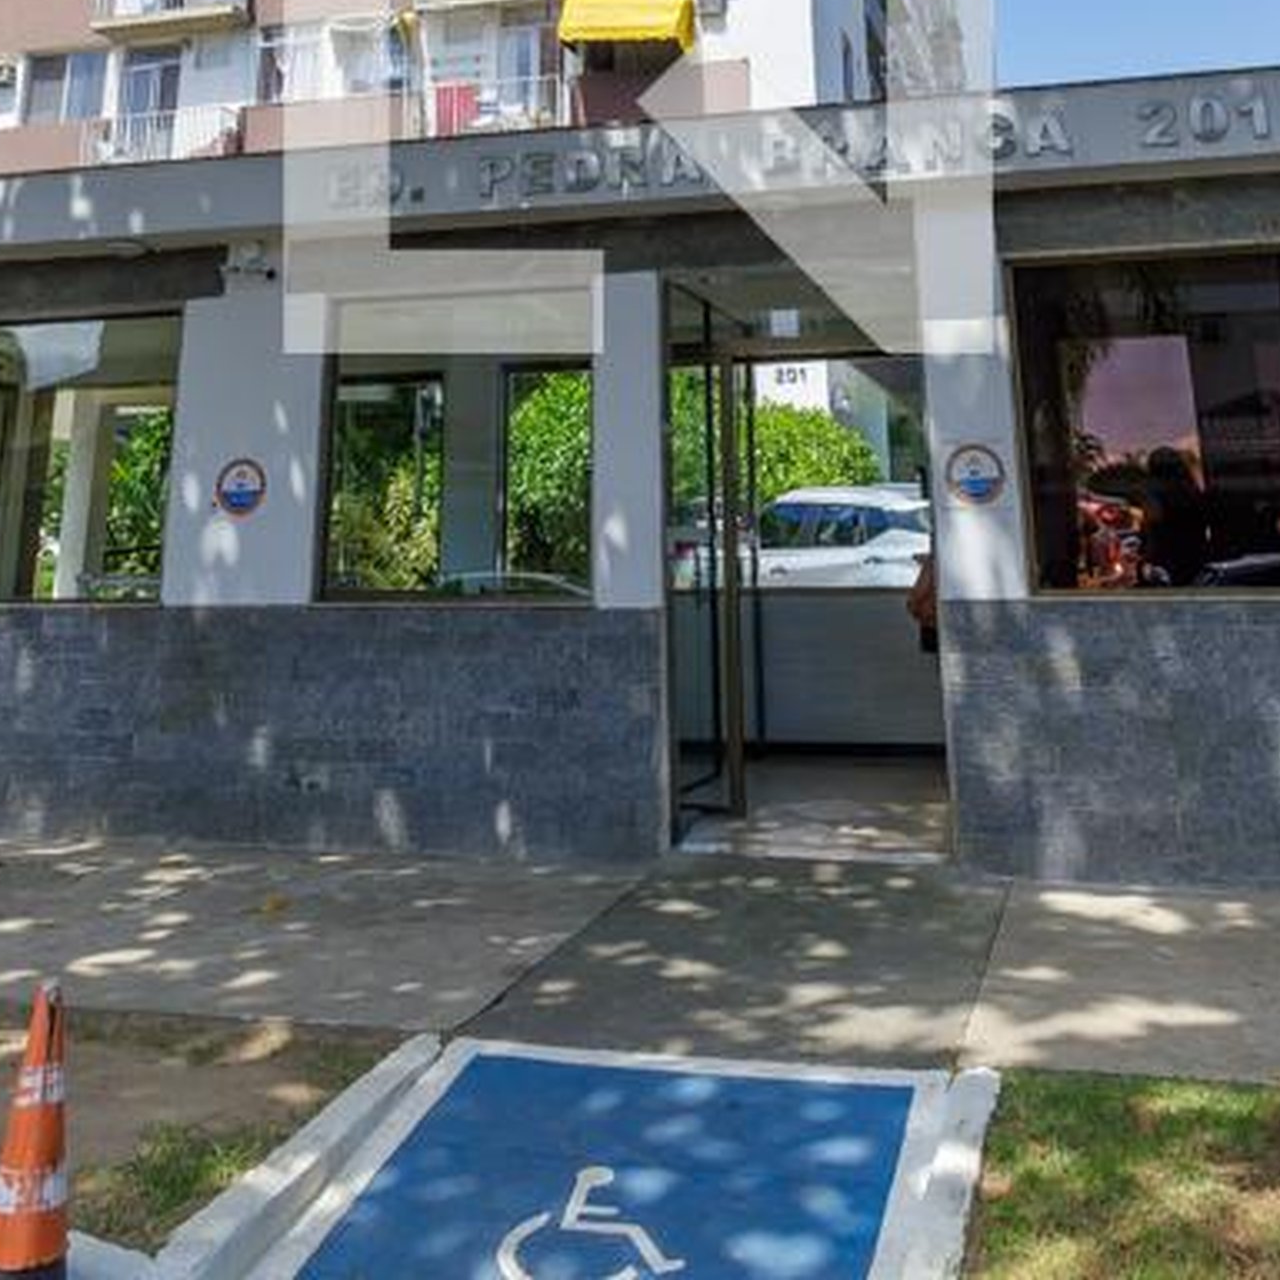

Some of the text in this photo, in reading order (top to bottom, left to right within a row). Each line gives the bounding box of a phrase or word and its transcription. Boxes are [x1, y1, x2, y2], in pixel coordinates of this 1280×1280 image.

[325, 163, 425, 206] ED.
[477, 138, 707, 198] PEDRA
[763, 107, 1074, 174] BRANCA
[1138, 93, 1272, 148] 201
